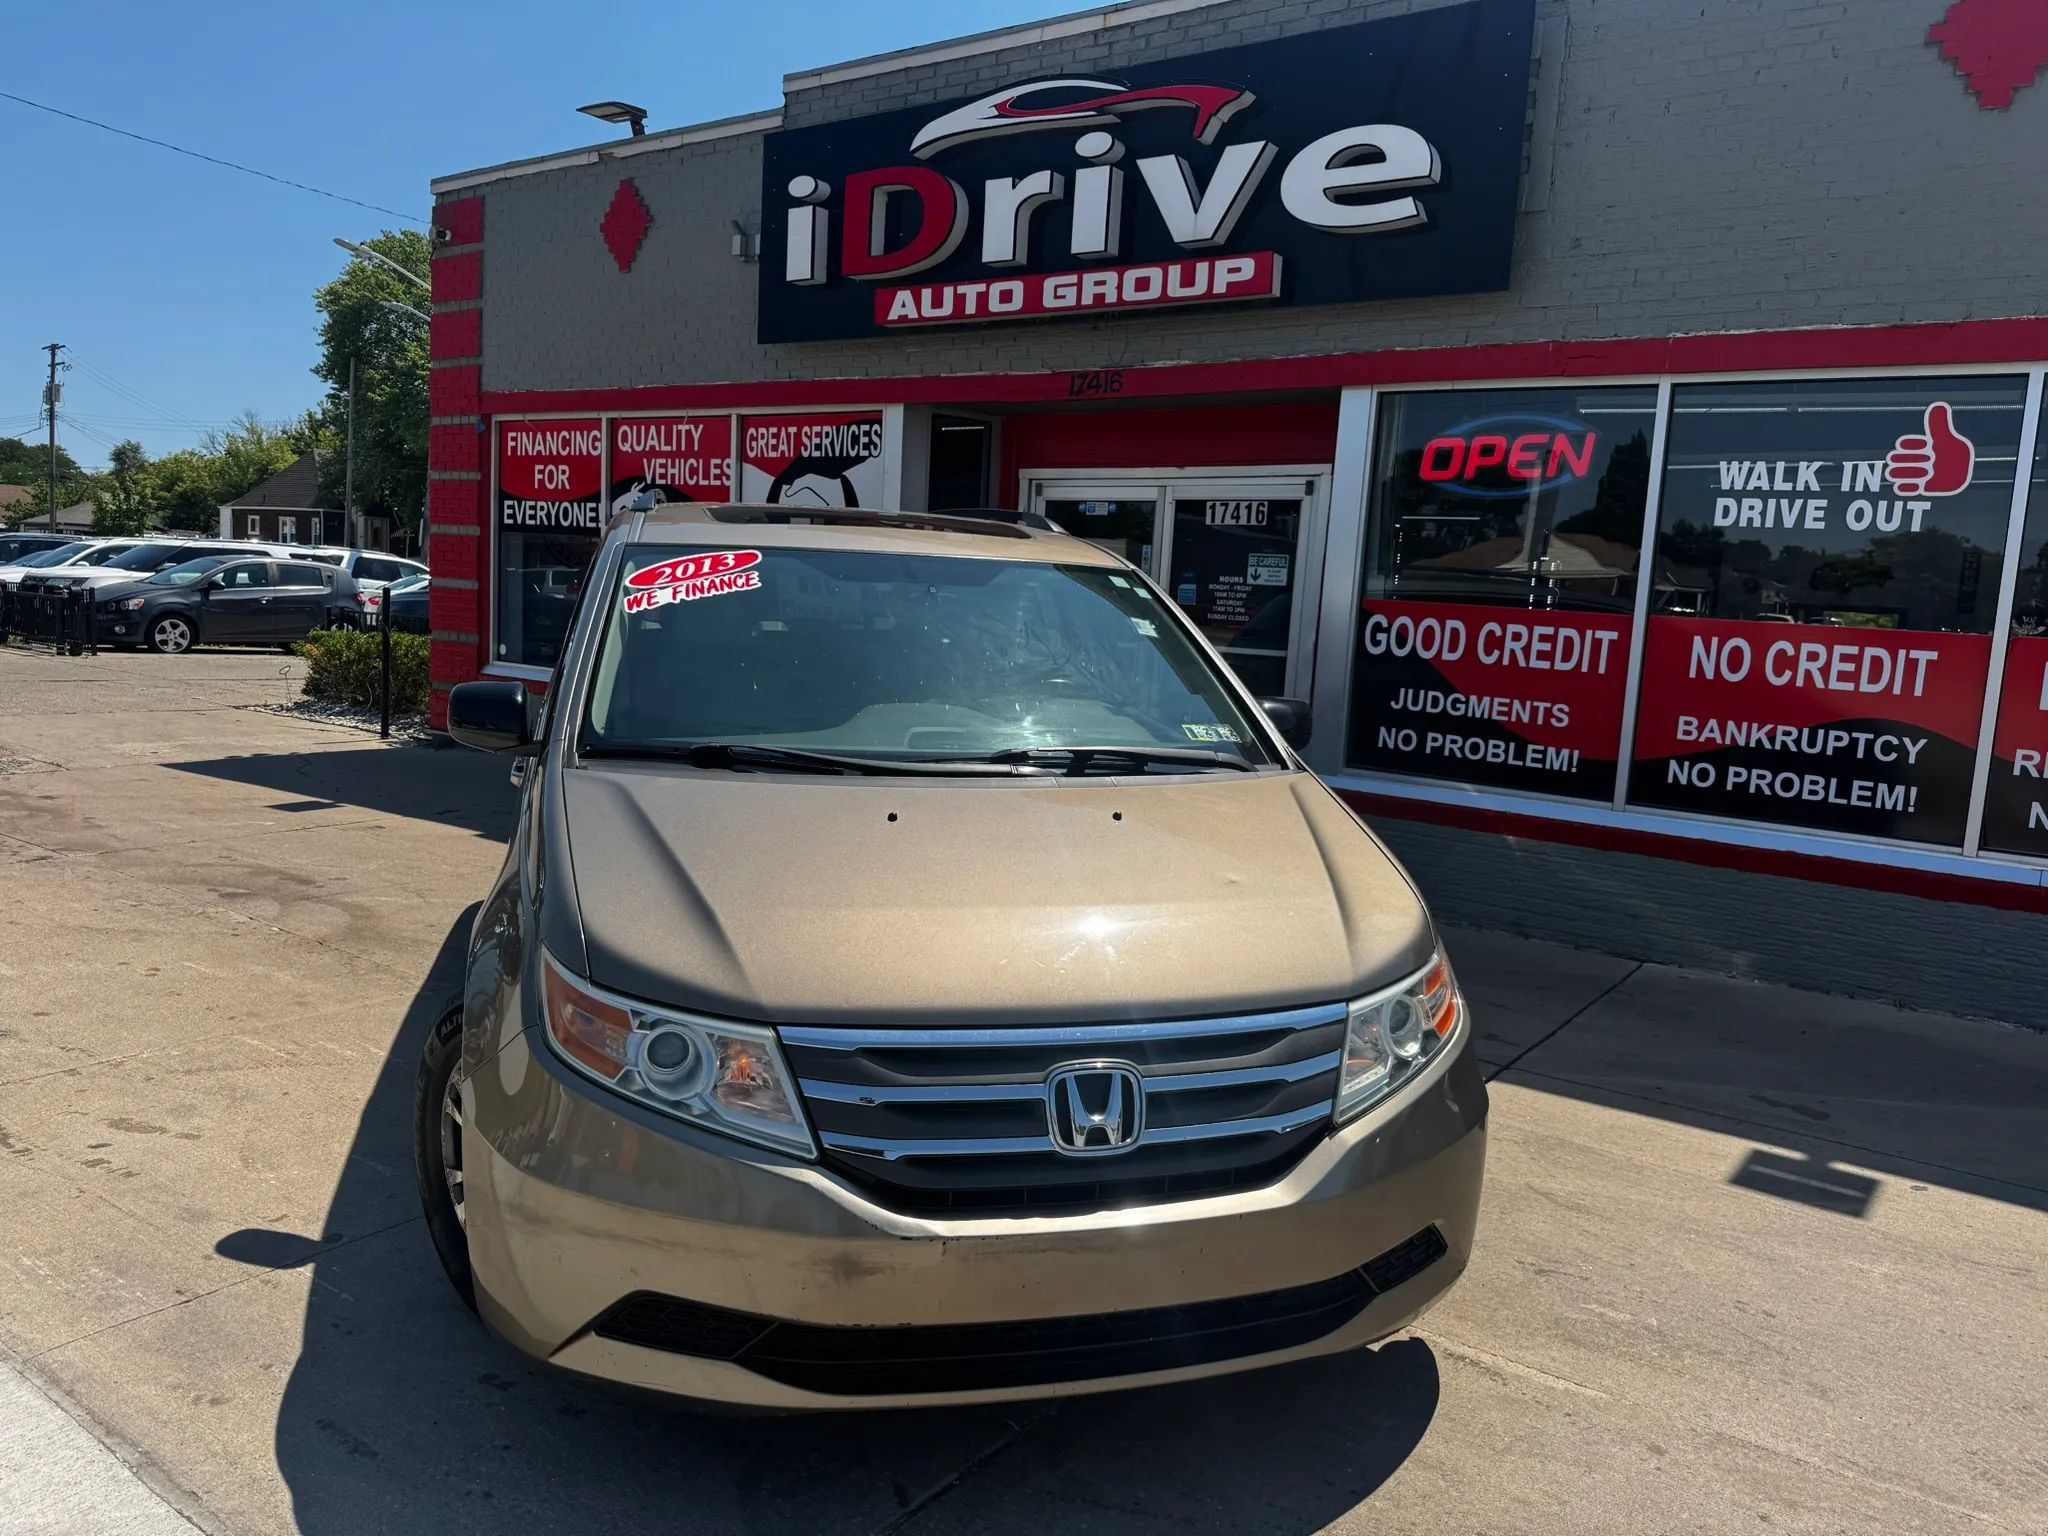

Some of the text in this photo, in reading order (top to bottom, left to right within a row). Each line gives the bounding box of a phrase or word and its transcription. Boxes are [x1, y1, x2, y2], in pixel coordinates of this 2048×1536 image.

[786, 123, 1441, 286] iDrive
[886, 257, 1256, 321] AUTO GROUP
[506, 430, 602, 457] FINANCING
[617, 424, 704, 453] QUALITY
[746, 423, 882, 458] GREAT SERVICES
[643, 457, 732, 487] VEHICLES
[1419, 432, 1596, 482] OPEN
[534, 464, 571, 490] FOR
[1718, 460, 1885, 492] WALK IN
[1208, 502, 1266, 524] 17416
[1714, 497, 1932, 532] DRIVE OUT
[655, 554, 735, 585] 2013
[1248, 556, 1287, 567] BE CAREFUL
[626, 572, 760, 612] WE FINANCE
[1219, 576, 1244, 584] HOURS
[1364, 614, 1618, 675] GOOD CREDIT
[1688, 635, 1939, 698] NO CREDIT
[1390, 687, 1570, 728] JUDGMENTS
[1377, 726, 1580, 774] NO PROBLEM!
[1676, 716, 1929, 766] BANKRUPTCY
[1666, 760, 1919, 813] NO PROBLEM!
